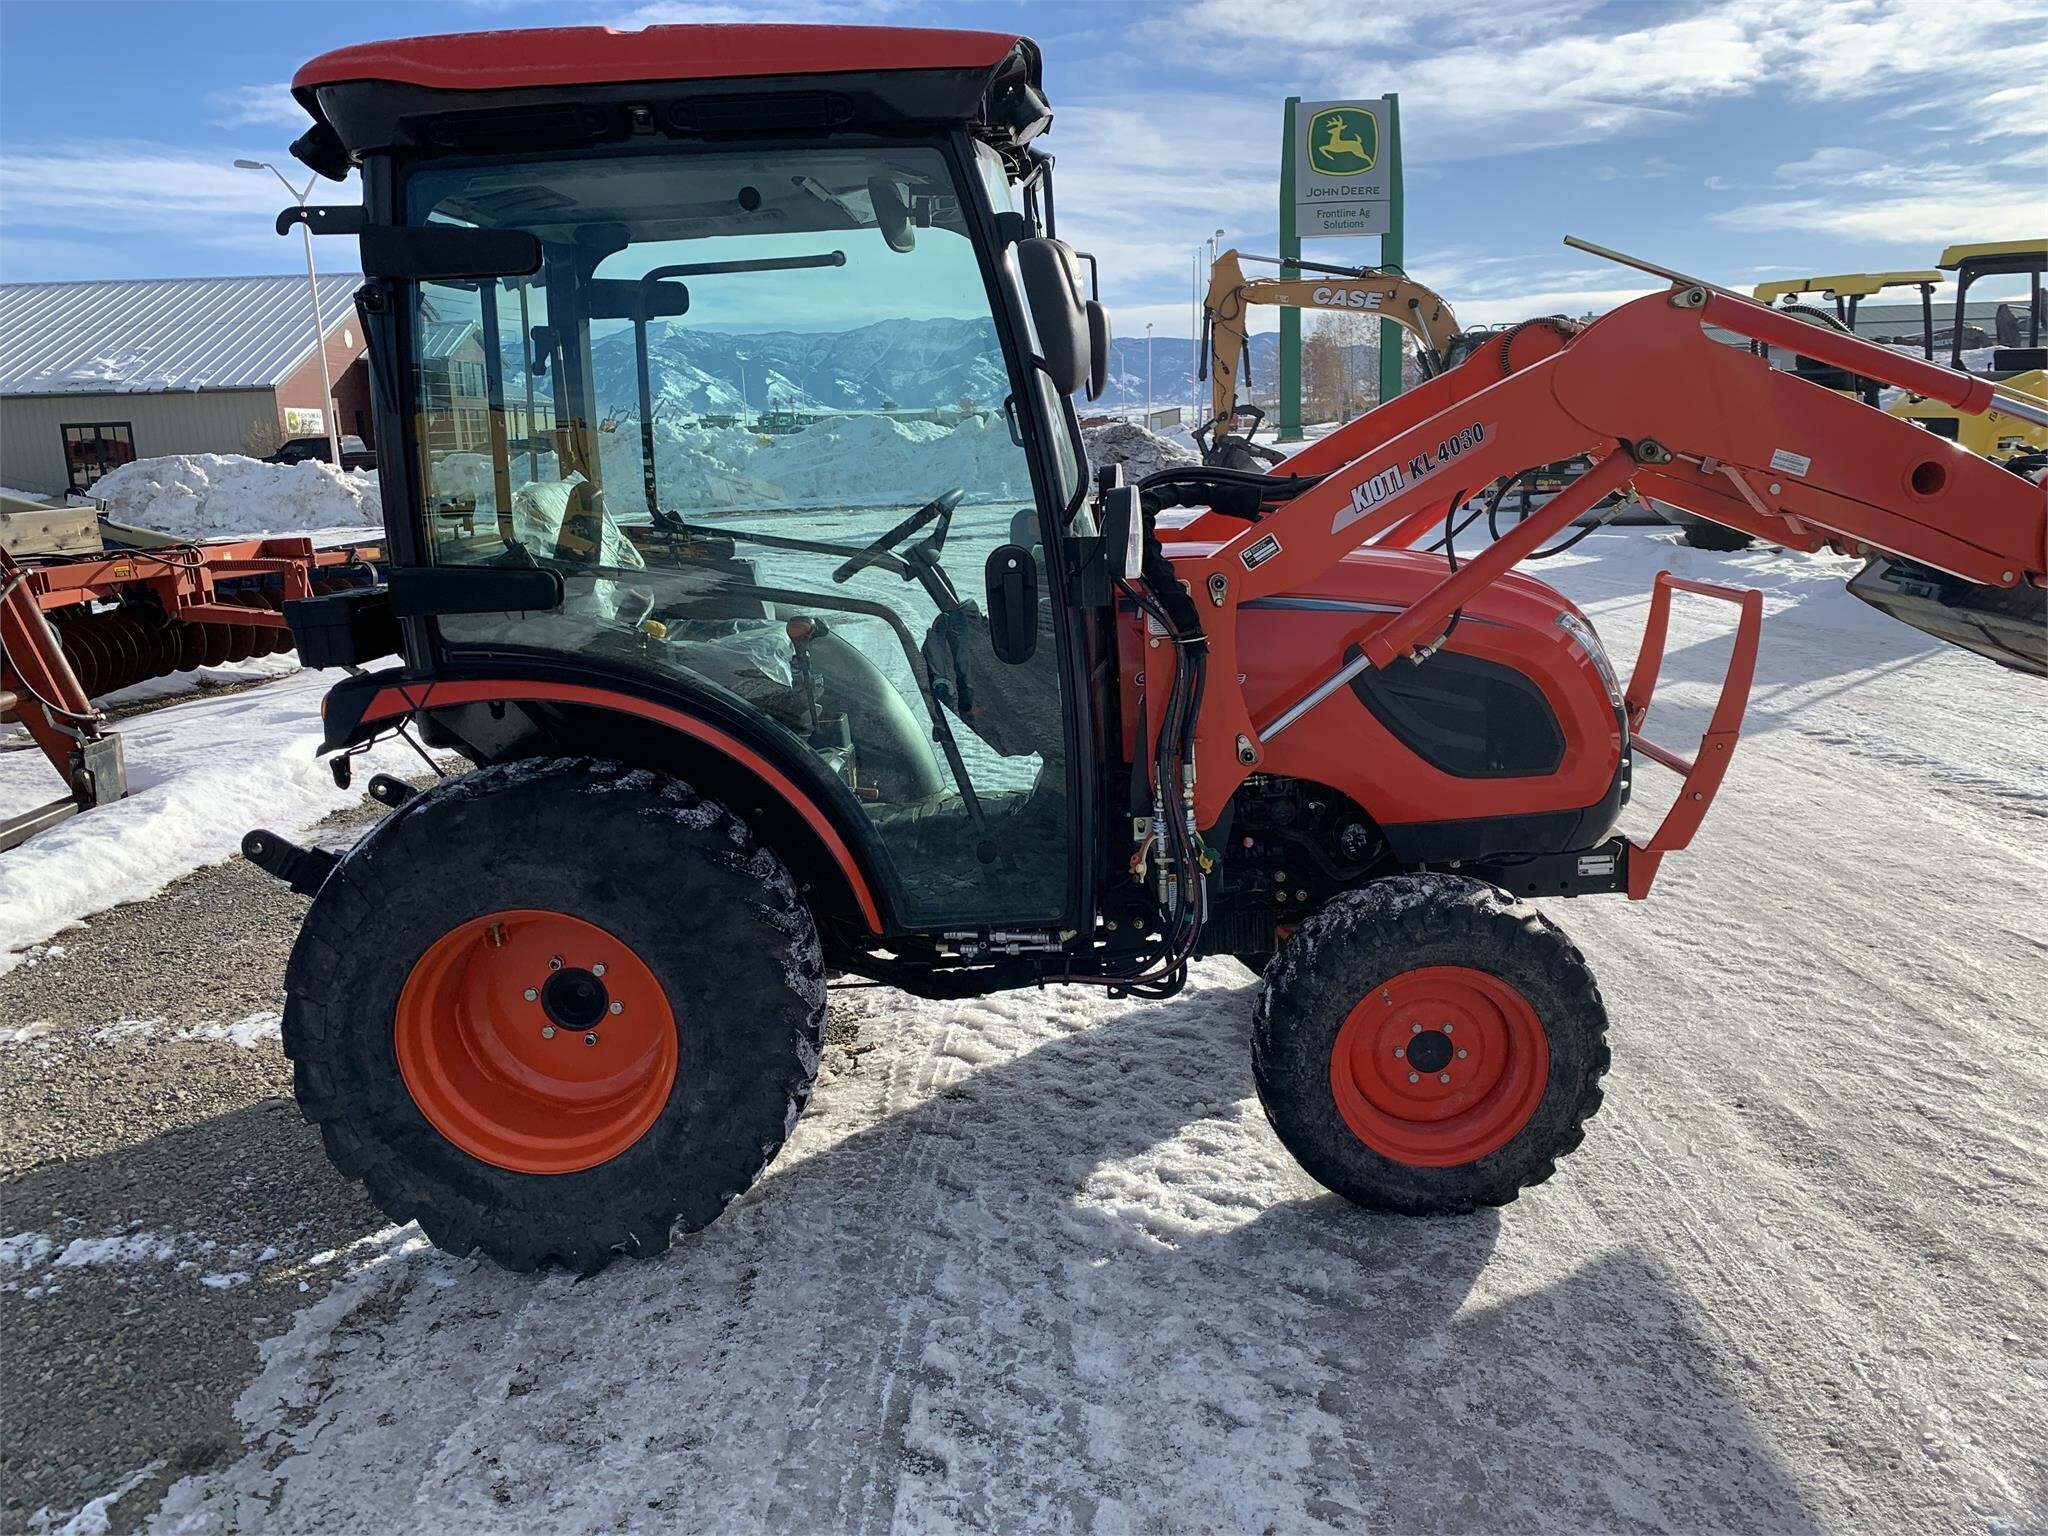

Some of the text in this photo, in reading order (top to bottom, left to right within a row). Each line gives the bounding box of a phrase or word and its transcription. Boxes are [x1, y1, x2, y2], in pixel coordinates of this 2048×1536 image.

[1306, 185, 1380, 198] JOHN DEERE
[1316, 207, 1371, 219] Frontline Ag
[1323, 220, 1365, 230] Solutions
[1312, 286, 1384, 309] CASE
[1350, 422, 1486, 514] KIOTI KL 4030
